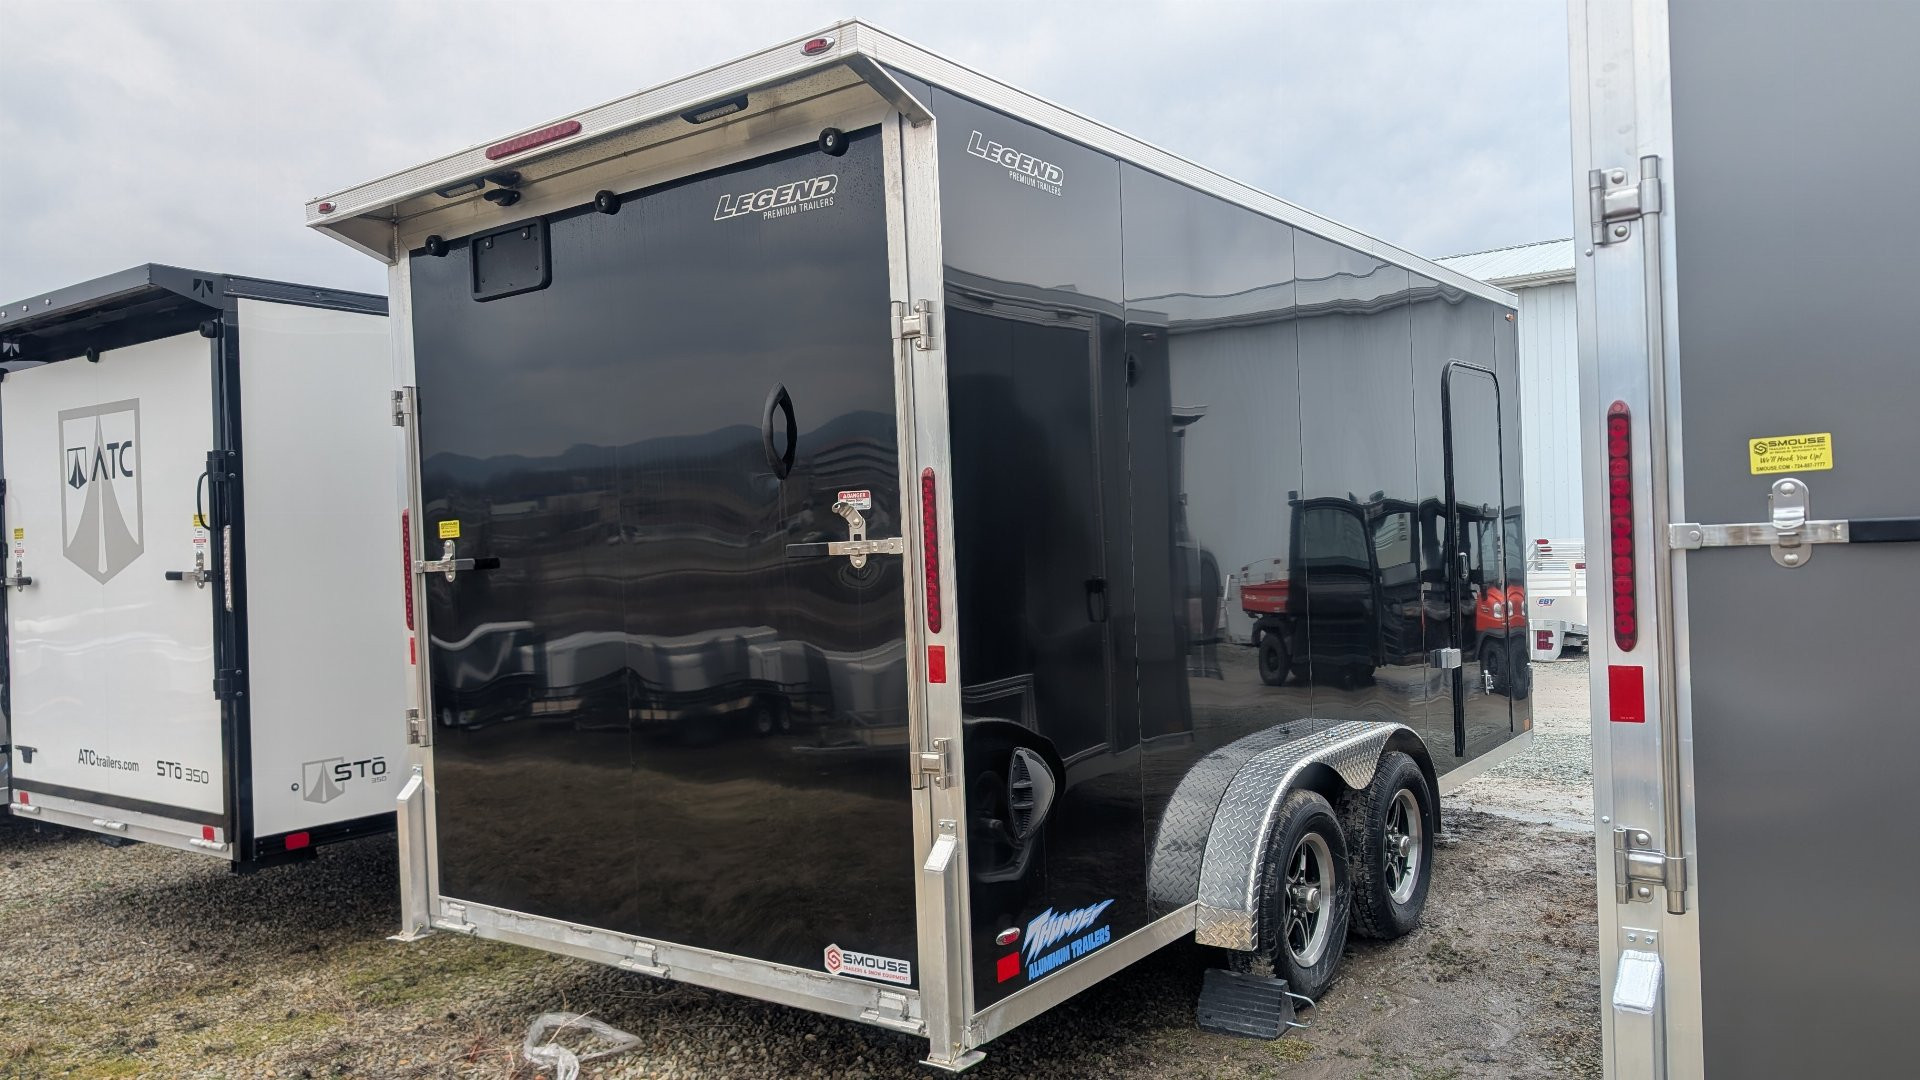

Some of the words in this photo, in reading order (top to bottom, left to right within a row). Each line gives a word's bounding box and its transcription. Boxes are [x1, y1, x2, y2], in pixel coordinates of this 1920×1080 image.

[967, 130, 1063, 184] LEGEND
[1009, 170, 1036, 187] PREMIUM
[1037, 180, 1062, 196] TRAILERS
[714, 174, 838, 220] LEGEND
[763, 206, 797, 220] PREMIUM
[799, 197, 834, 212] TRAILERS
[1768, 437, 1826, 447] SMOUSE
[91, 440, 133, 481] ATC
[1777, 454, 1794, 462] Hook
[78, 748, 140, 772] ATCtrailers.com
[185, 767, 209, 784] 350
[371, 775, 387, 784] 350
[1022, 899, 1114, 968] THUNDER
[842, 953, 908, 975] SMOUSE
[1028, 944, 1071, 981] ALUMINUM
[1070, 924, 1111, 959] TRAILERS
[843, 965, 863, 974] TRAILERS
[868, 969, 882, 977] SNOW
[882, 972, 908, 981] EQUIPMENT
